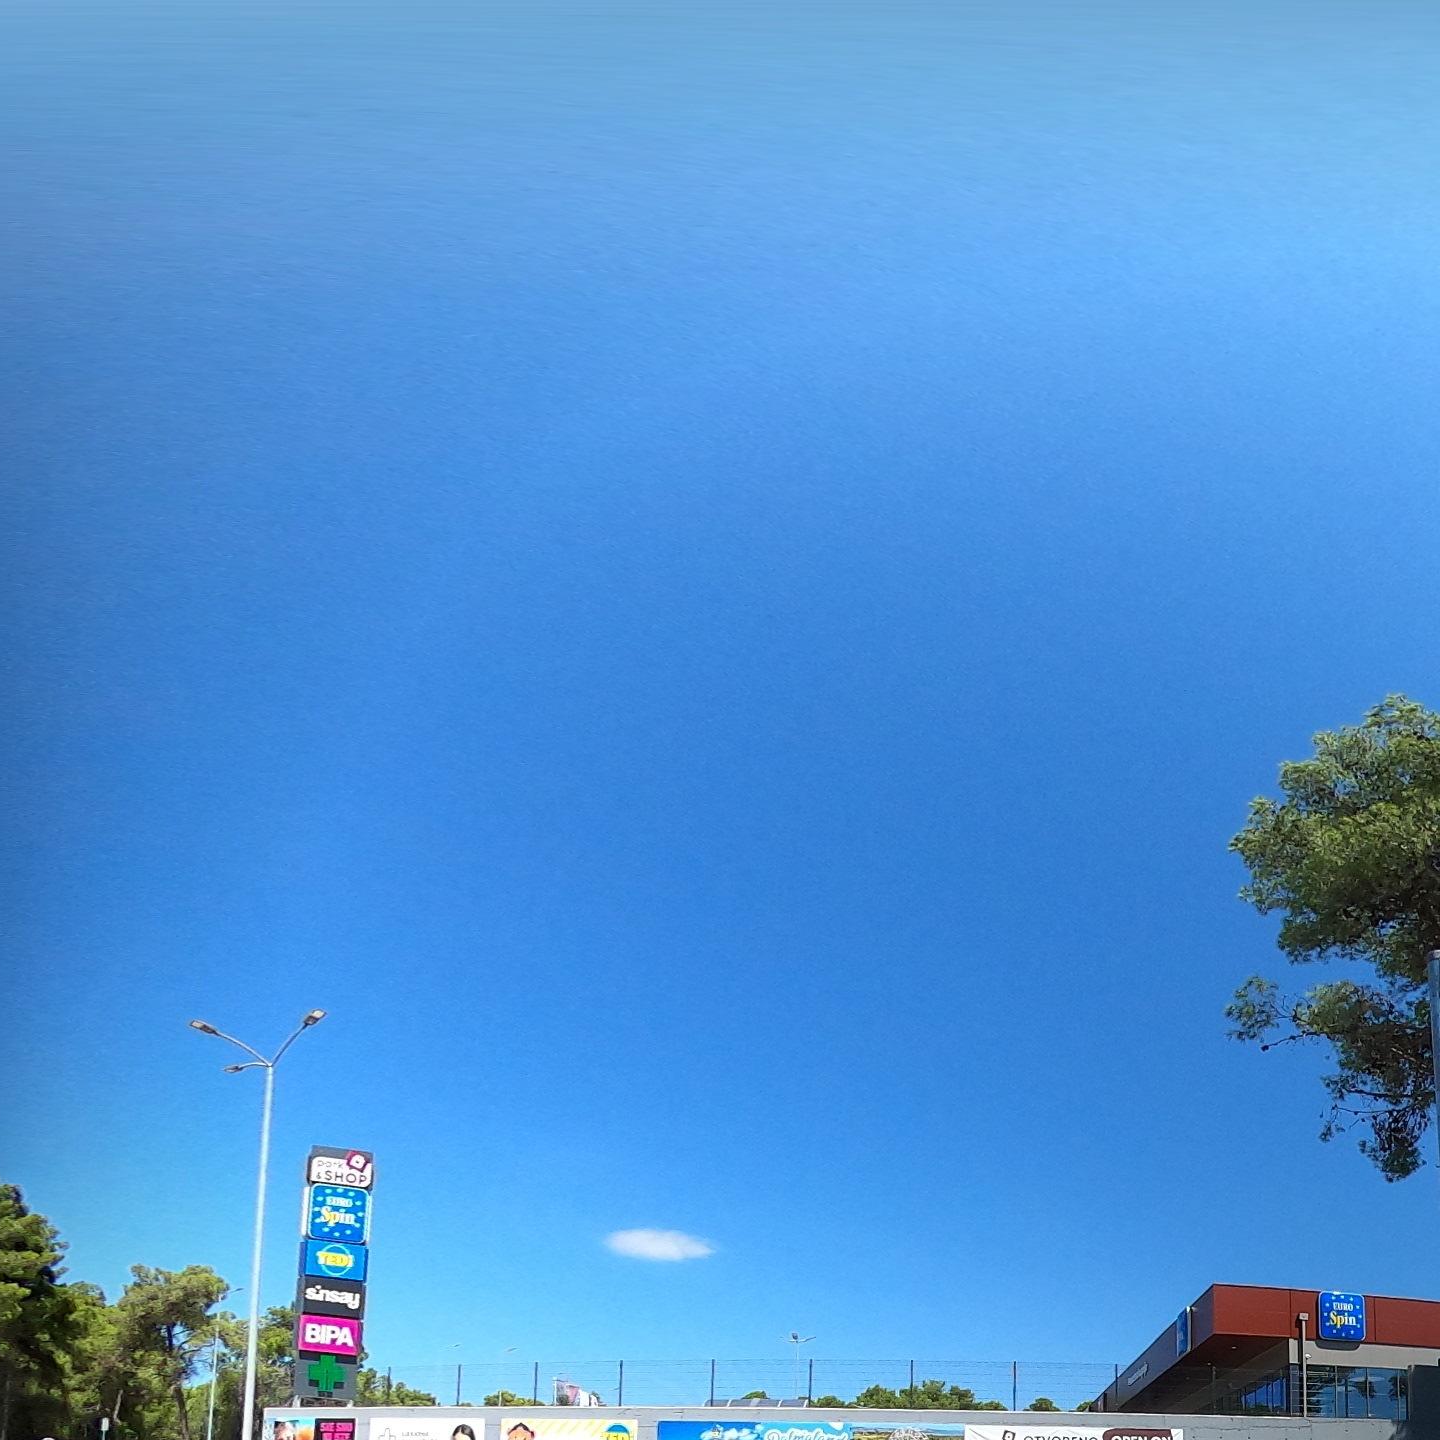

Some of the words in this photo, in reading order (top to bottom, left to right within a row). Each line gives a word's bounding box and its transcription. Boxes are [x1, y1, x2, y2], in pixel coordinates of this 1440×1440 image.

[324, 1170, 368, 1185] SHOP
[305, 1285, 360, 1310] sinsay
[1332, 1302, 1354, 1312] EURO
[1329, 1311, 1357, 1328] Spin
[304, 1322, 354, 1347] BIPA
